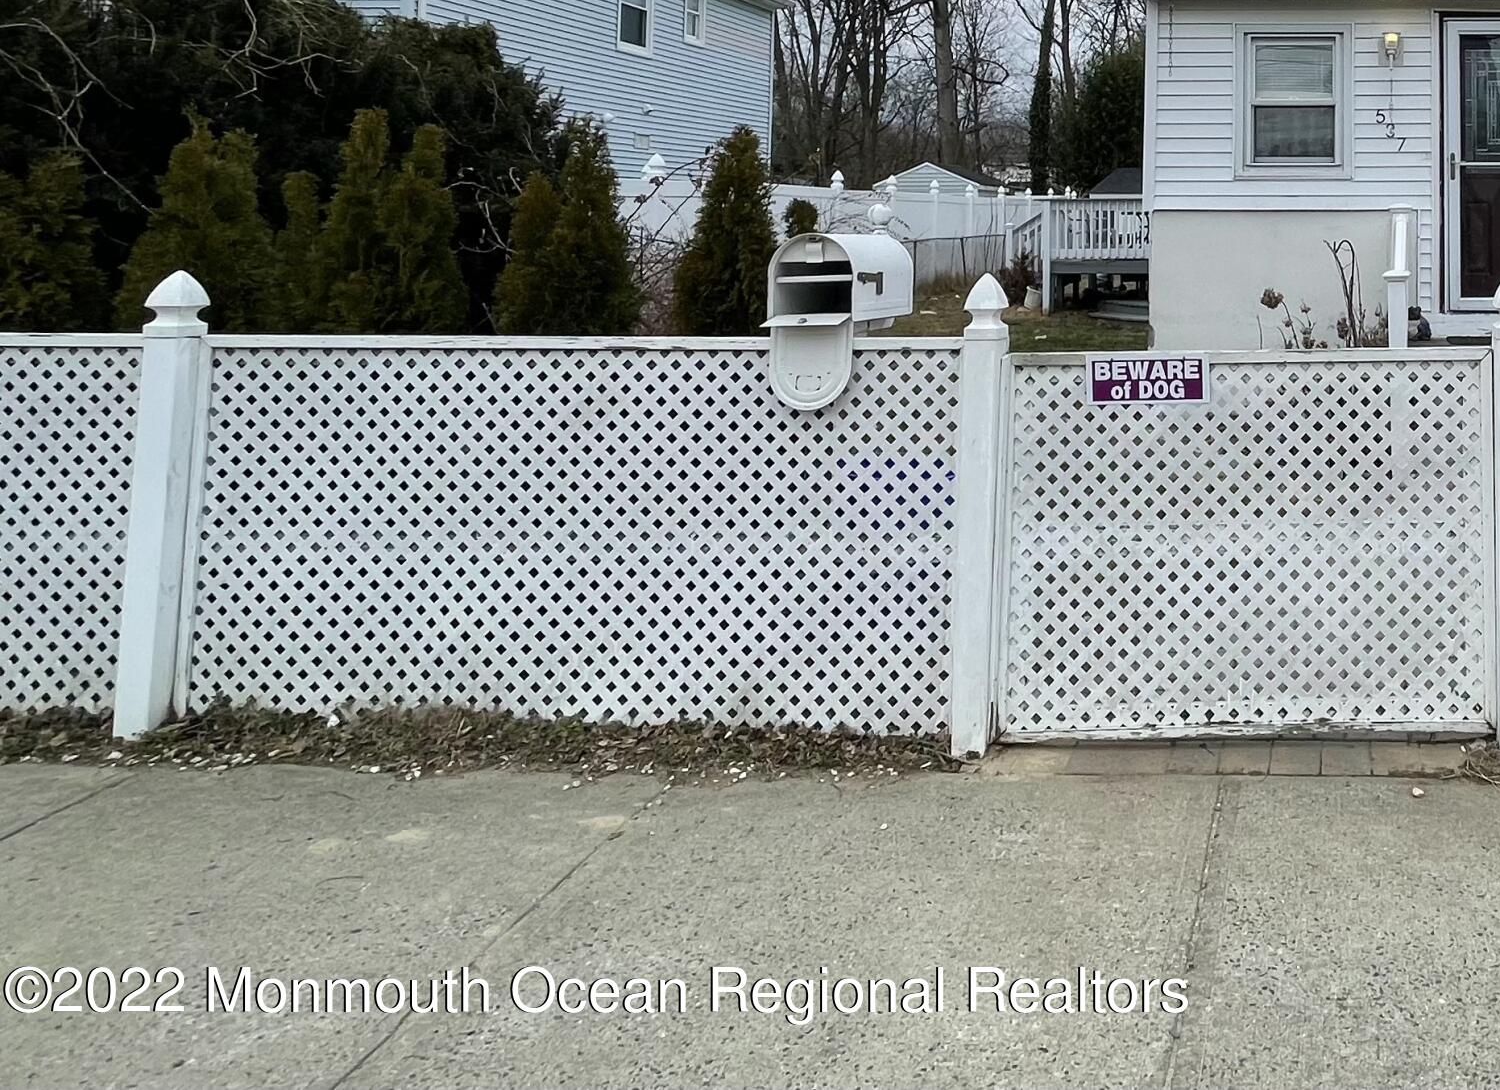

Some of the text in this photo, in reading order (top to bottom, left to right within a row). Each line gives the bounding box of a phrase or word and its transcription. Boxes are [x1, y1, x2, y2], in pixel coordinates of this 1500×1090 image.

[1375, 109, 1407, 151] 537
[1094, 360, 1200, 380] BEWARE
[1110, 380, 1185, 399] of DOG
